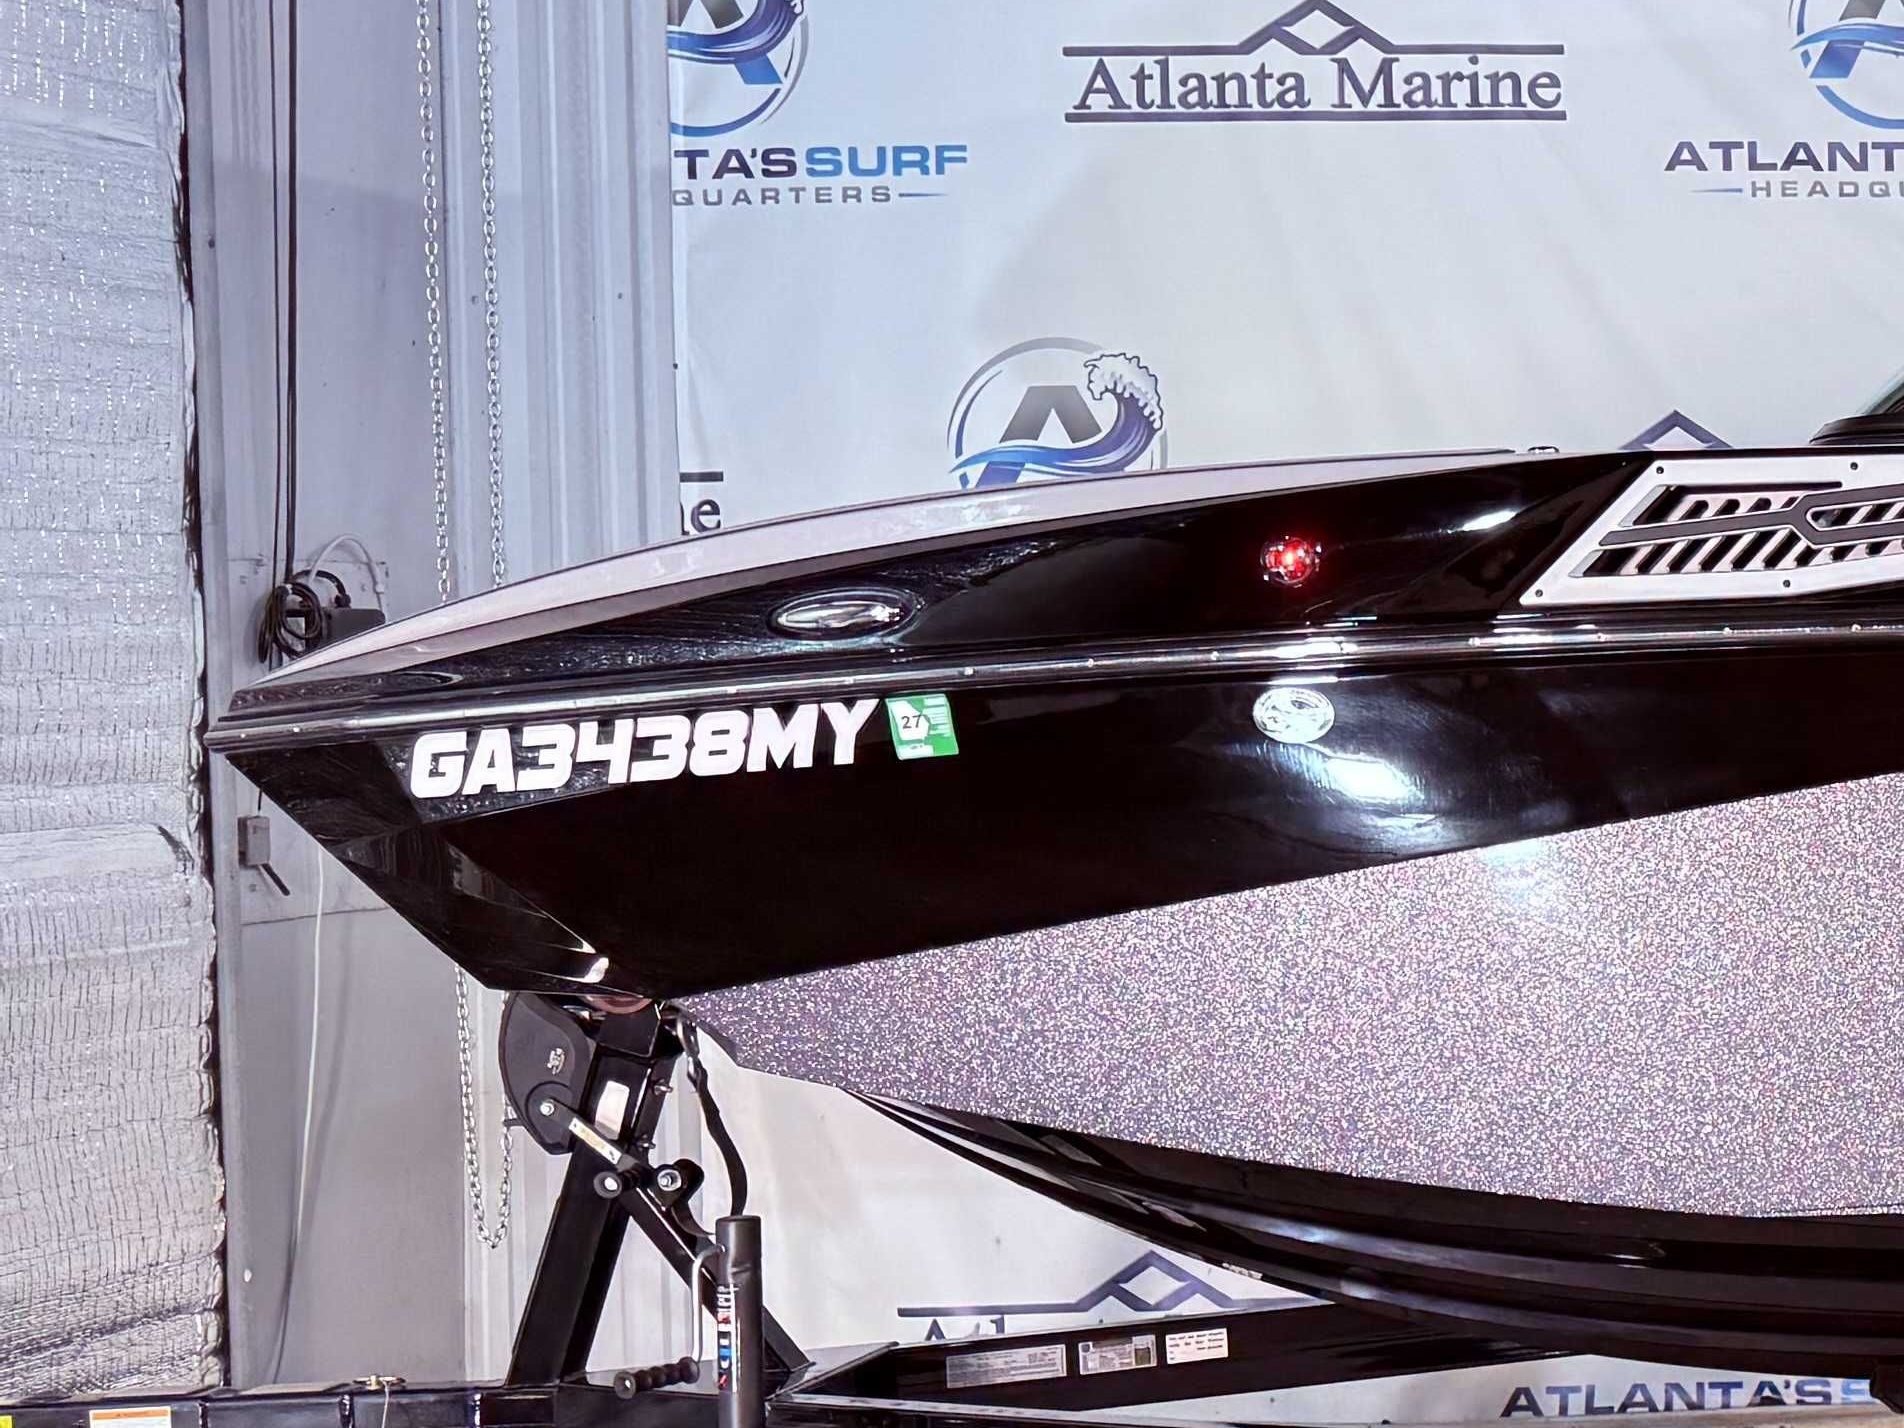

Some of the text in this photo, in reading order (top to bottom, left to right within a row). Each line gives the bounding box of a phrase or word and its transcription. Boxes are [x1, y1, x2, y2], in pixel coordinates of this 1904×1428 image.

[1070, 52, 1564, 110] Atlanta Marine
[409, 698, 881, 800] GA3438MY
[901, 714, 922, 730] 27
